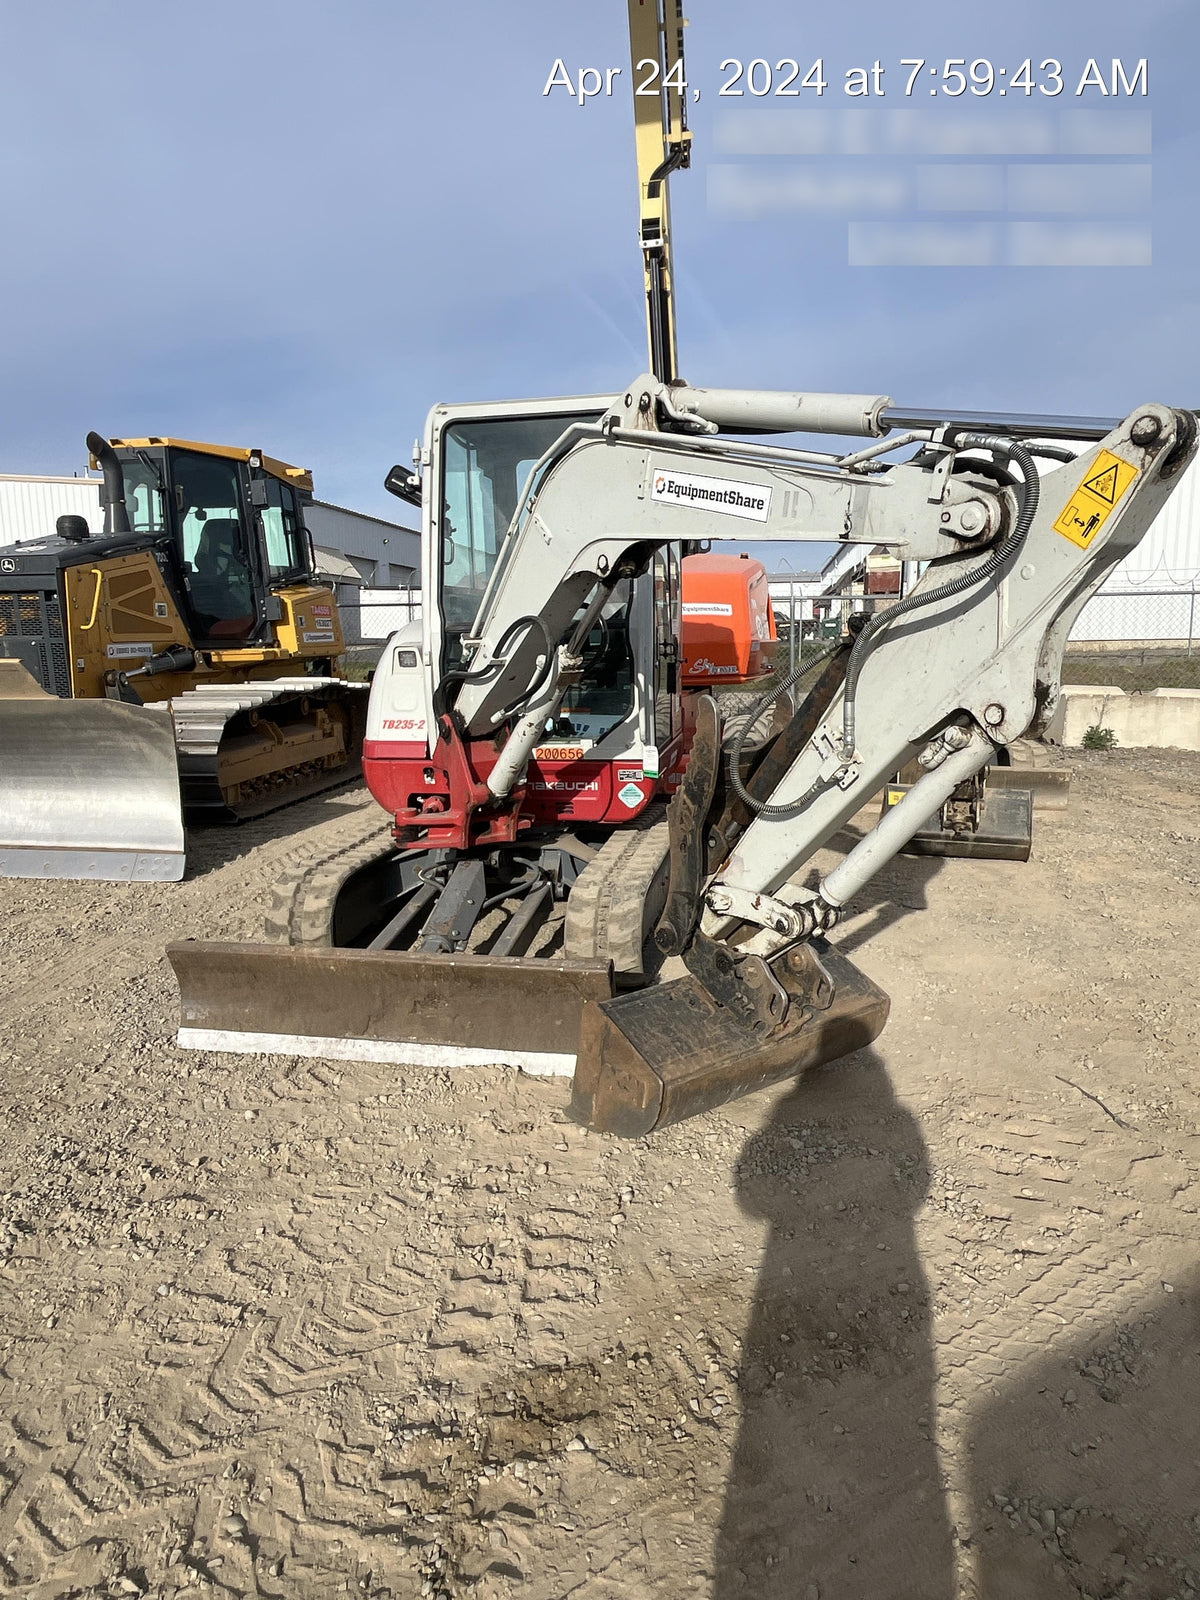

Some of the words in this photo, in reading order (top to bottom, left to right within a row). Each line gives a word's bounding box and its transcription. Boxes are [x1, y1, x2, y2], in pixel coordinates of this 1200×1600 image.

[667, 480, 765, 510] EquipmentShare
[382, 719, 426, 730] TB235-2
[536, 748, 584, 759] 200656
